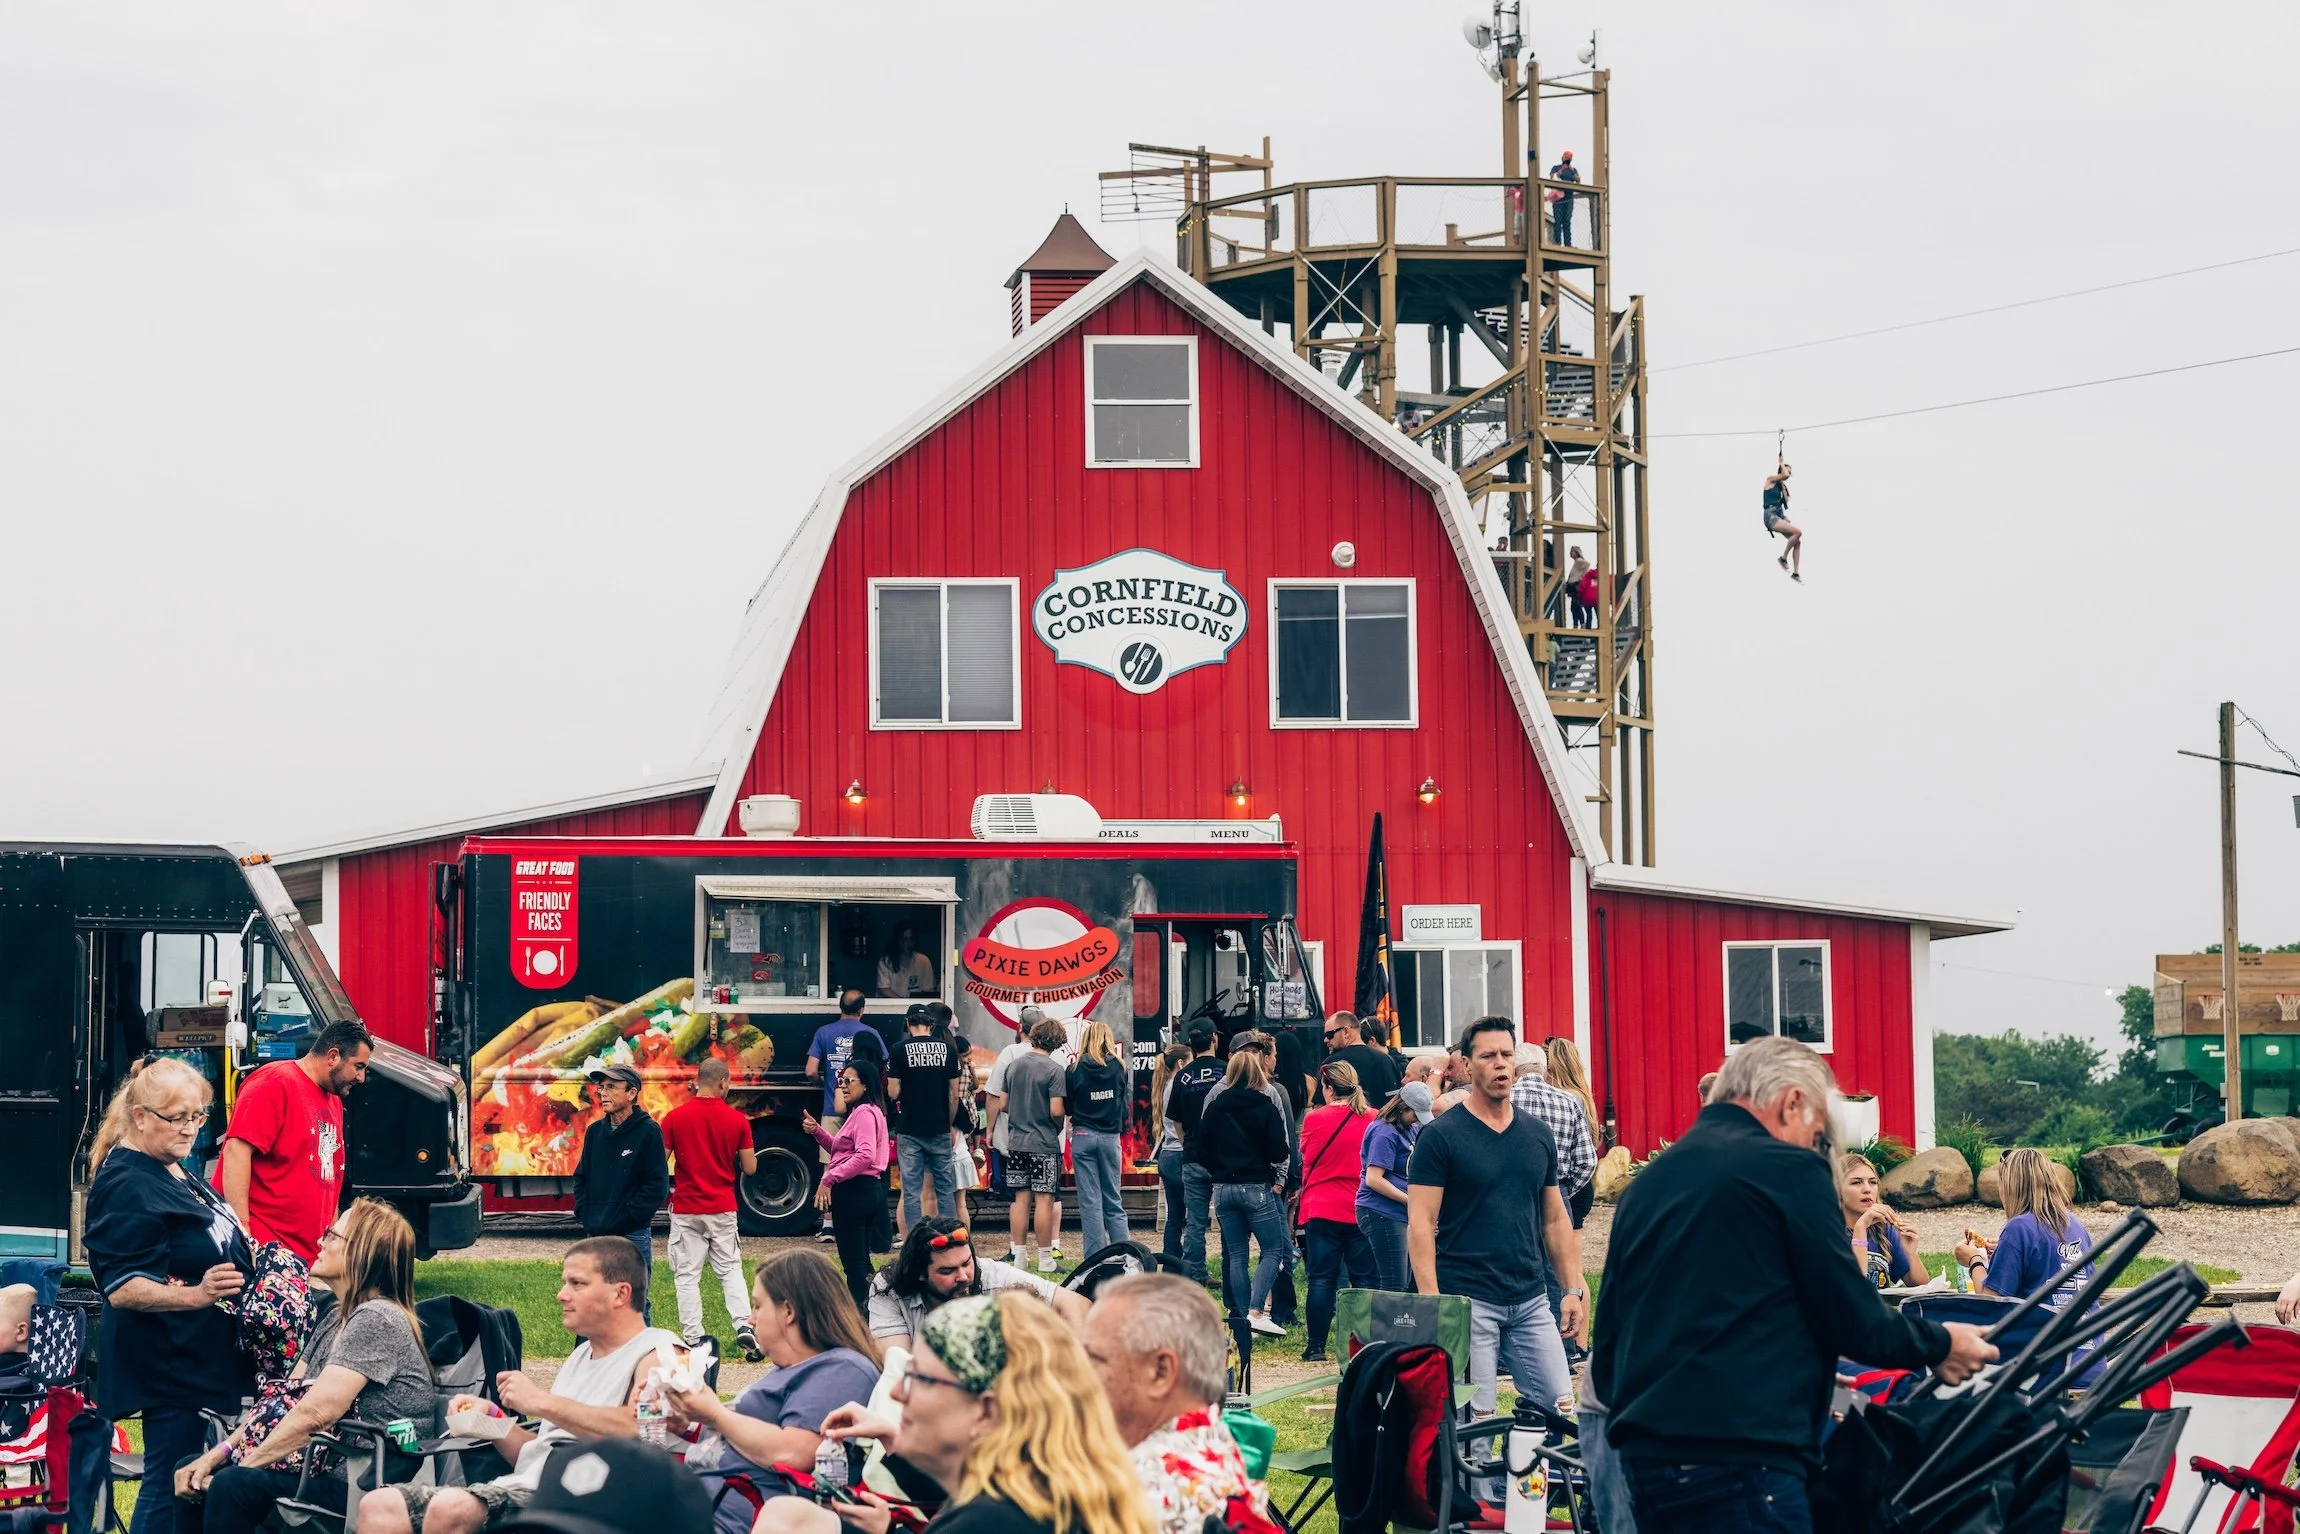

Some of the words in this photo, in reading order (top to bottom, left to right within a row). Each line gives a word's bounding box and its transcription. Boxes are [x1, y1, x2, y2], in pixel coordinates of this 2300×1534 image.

[1043, 577, 1238, 618] CORNFIELD
[1047, 606, 1233, 642] CONCESSIONS
[1098, 830, 1139, 838] DEALS
[1210, 830, 1249, 838] MENU
[515, 861, 549, 876] GREAT
[549, 861, 575, 876] FOOD
[519, 891, 571, 911] FRIENDLY
[528, 912, 562, 931] FACES
[1410, 918, 1445, 929] ORDER
[1447, 918, 1473, 929] HERE
[973, 948, 1030, 976] PIXIE
[1038, 940, 1108, 976] DAWGS
[965, 981, 1030, 1004] GOURMET
[1033, 968, 1124, 1004] CHUCKWAGON
[905, 1042, 925, 1055] BIG
[926, 1041, 947, 1054] DAD
[908, 1053, 947, 1067] ENERGY
[1091, 1090, 1114, 1101] HAGEN
